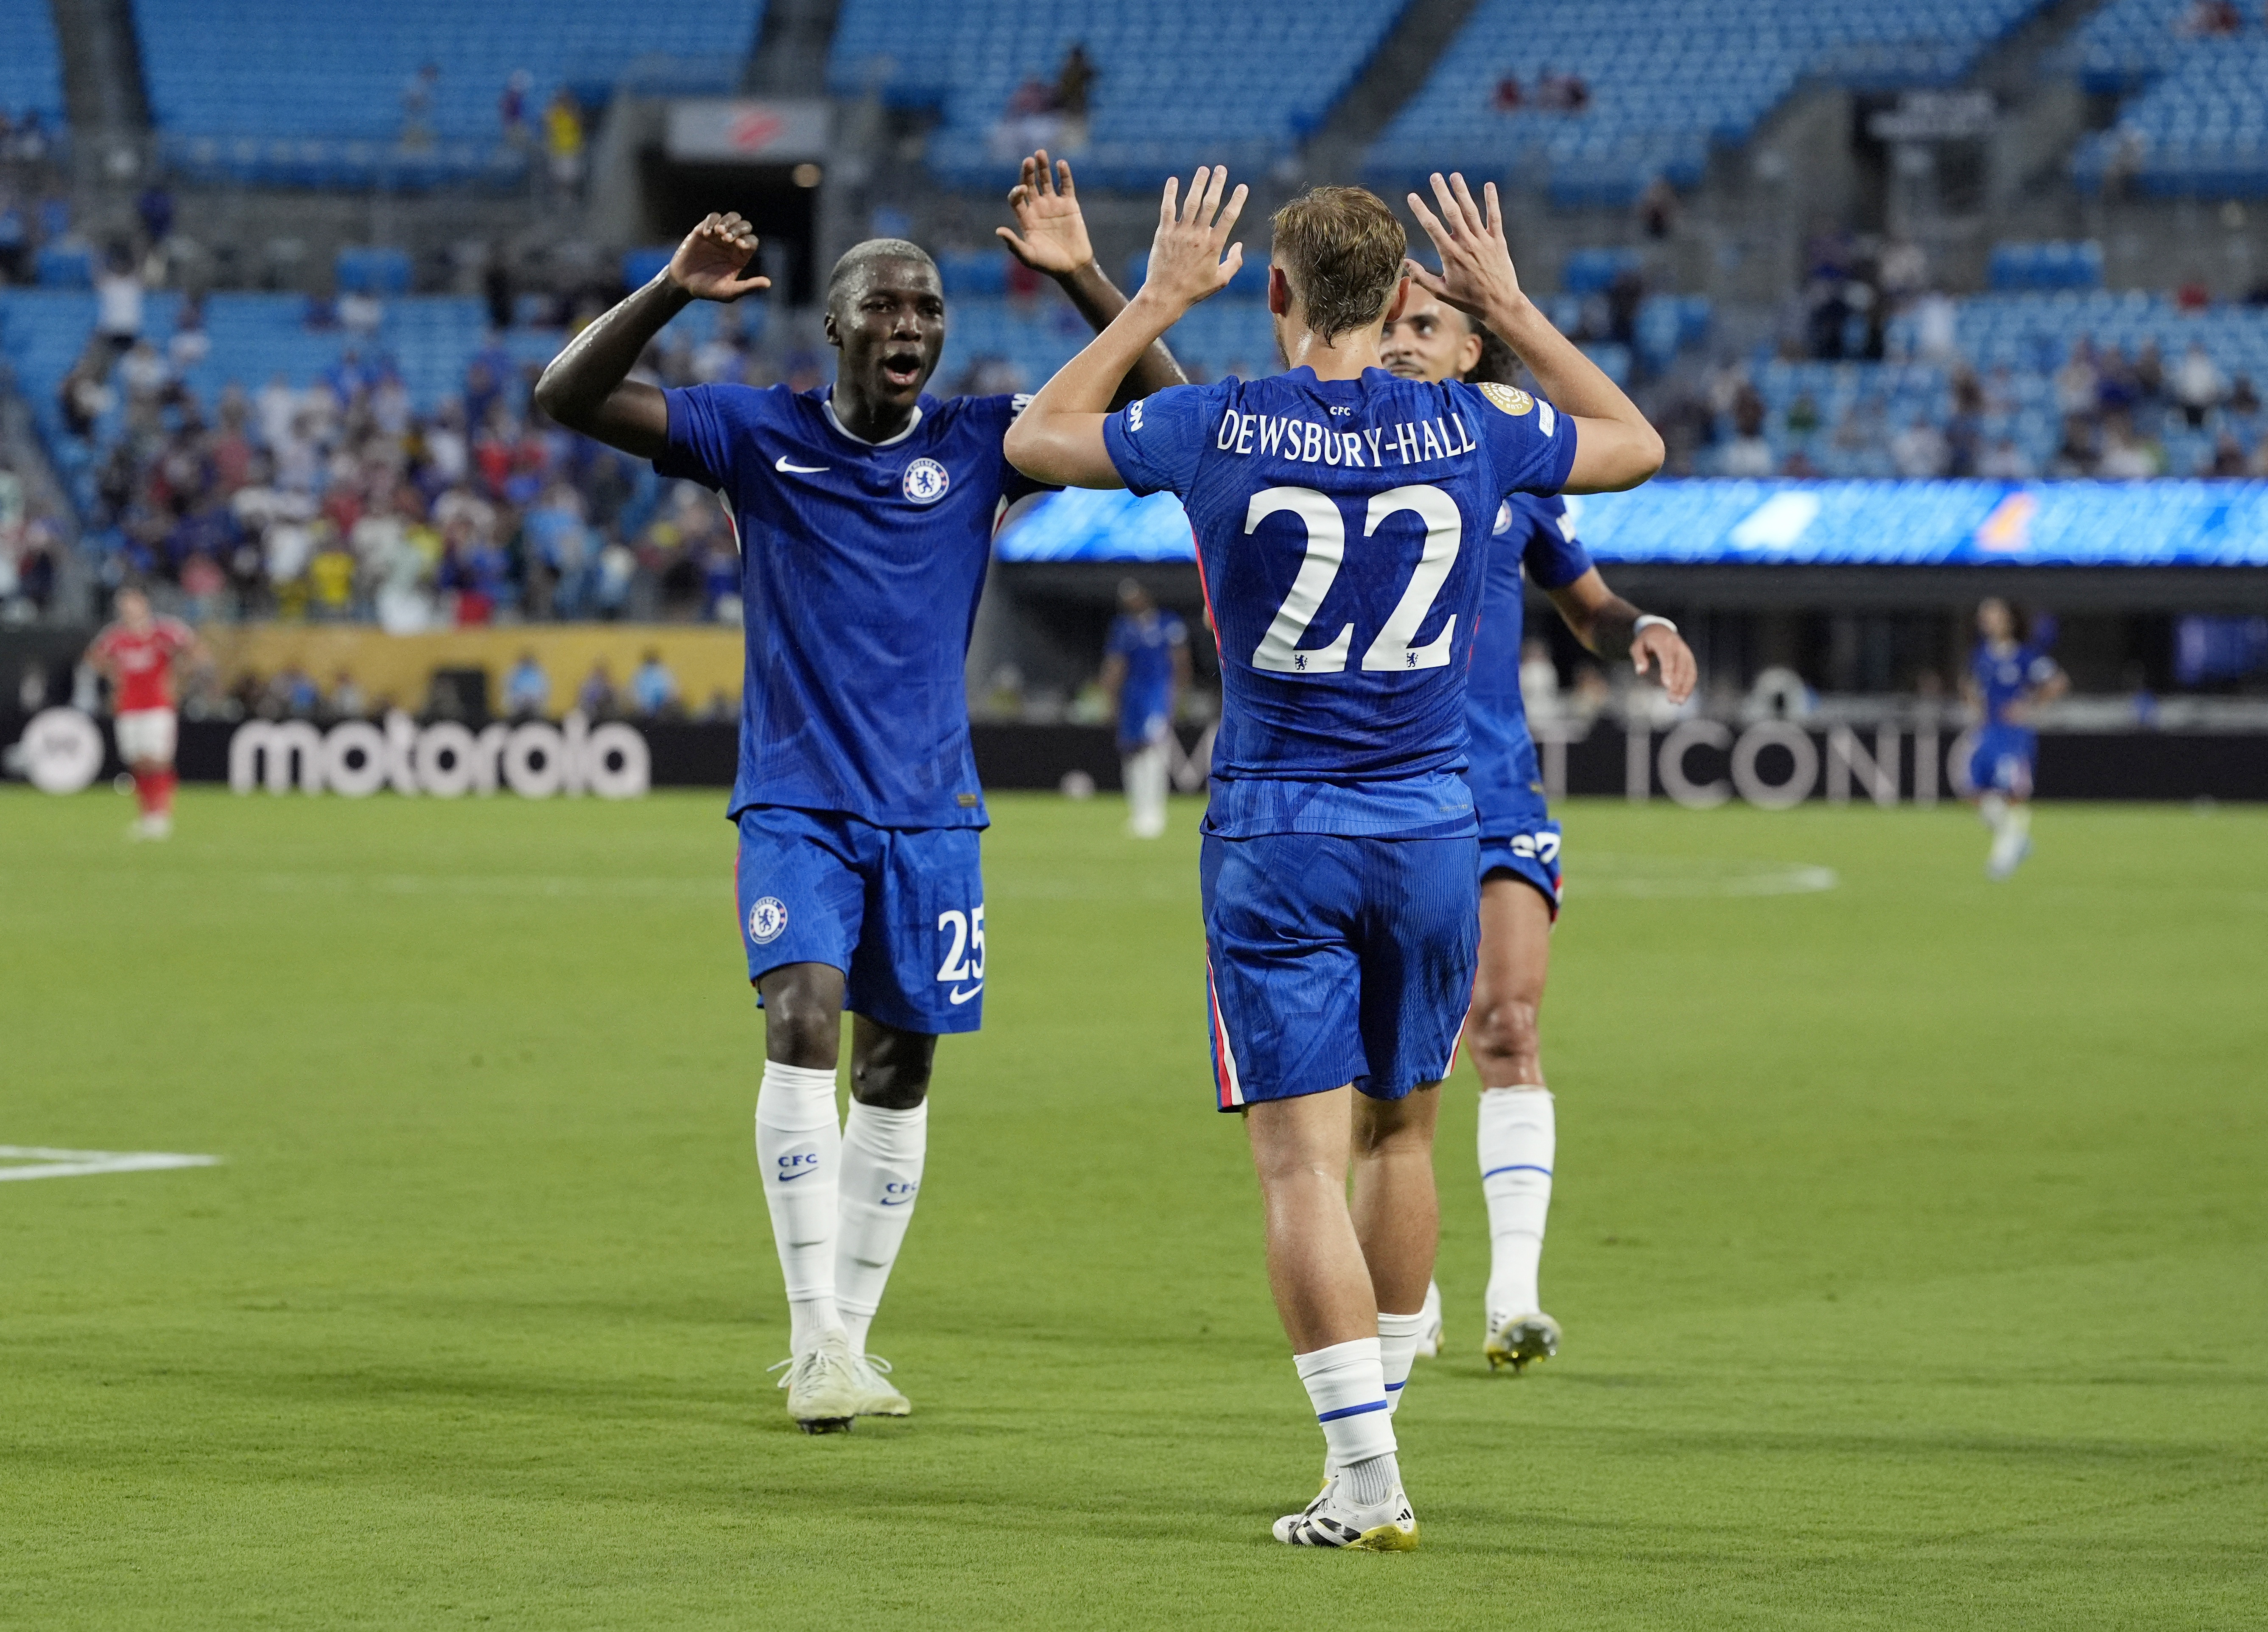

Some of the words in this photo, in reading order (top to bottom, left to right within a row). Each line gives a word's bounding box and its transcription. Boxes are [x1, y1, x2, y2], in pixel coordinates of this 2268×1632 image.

[1330, 406, 1351, 416] CFC
[1484, 386, 1504, 405] WORLD
[1216, 409, 1476, 467] DEWSBURY-HALL
[1244, 484, 1463, 673] 22
[229, 709, 651, 797] motorola
[936, 903, 985, 982] 25
[778, 1153, 818, 1168] CFC
